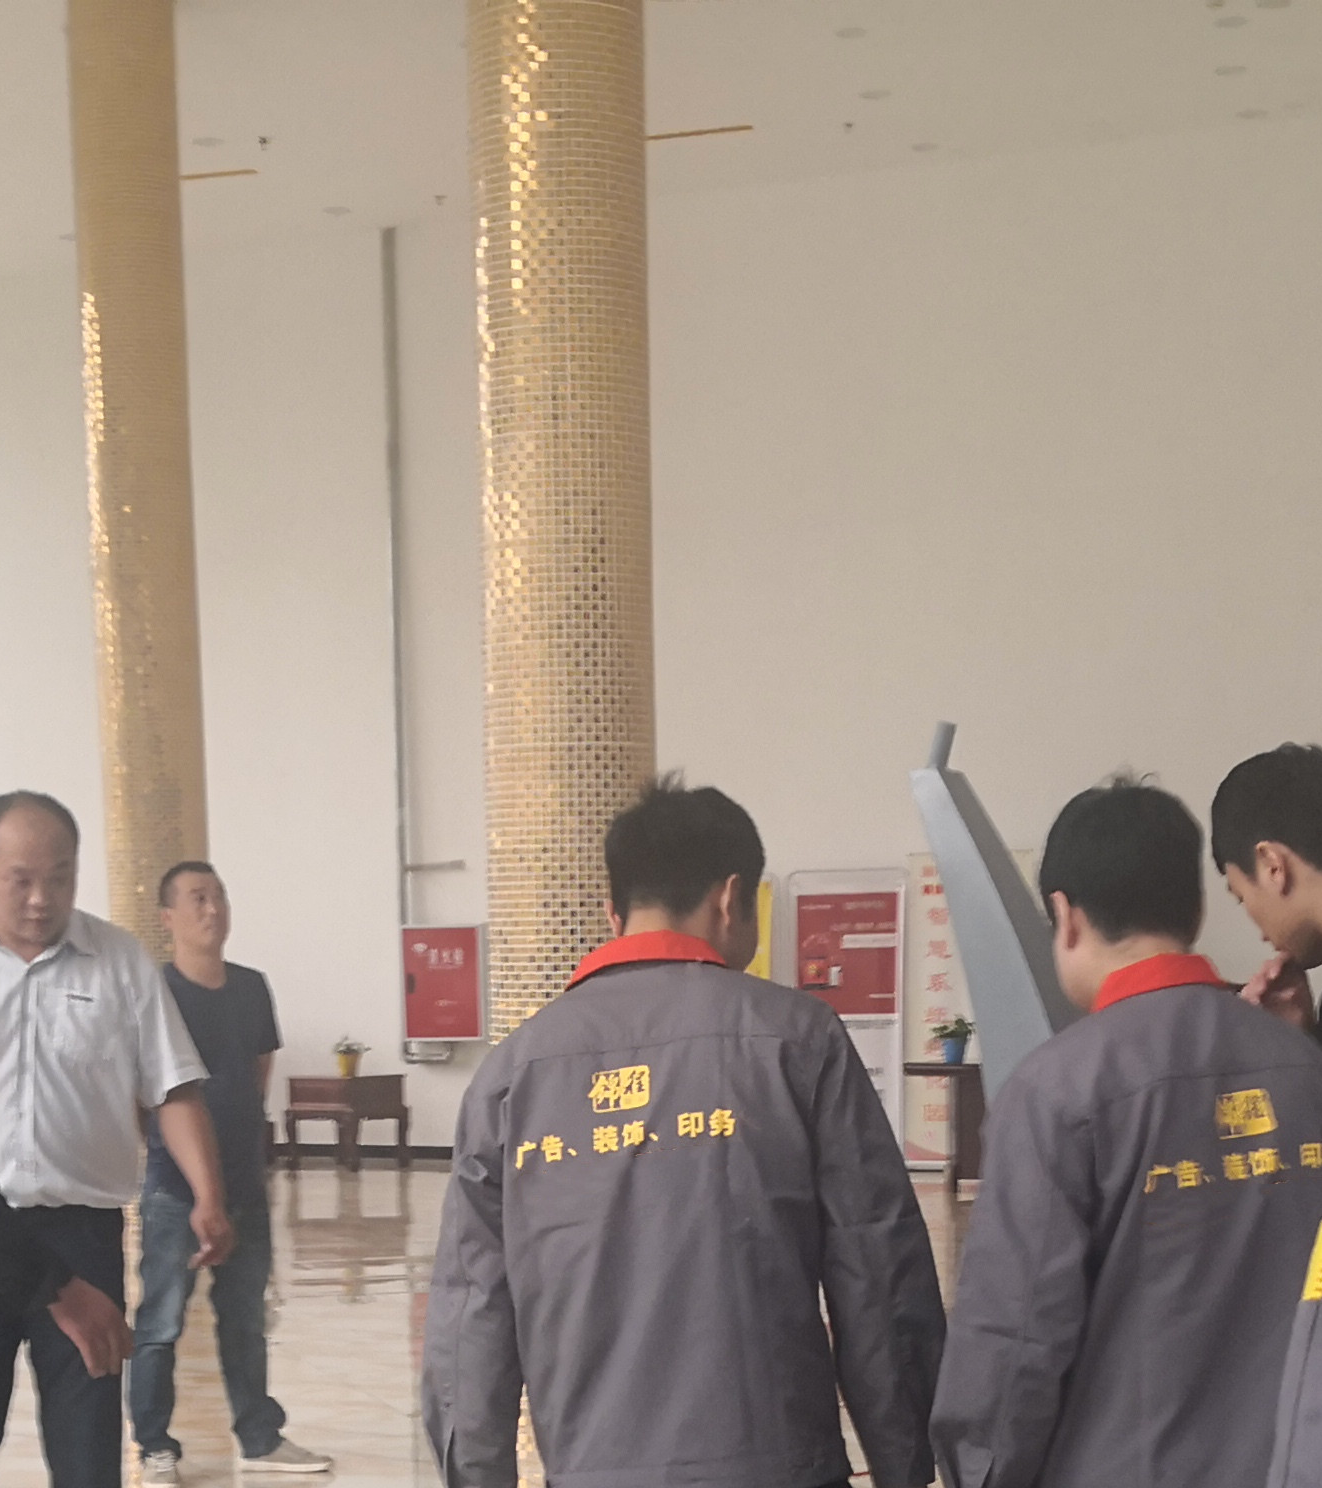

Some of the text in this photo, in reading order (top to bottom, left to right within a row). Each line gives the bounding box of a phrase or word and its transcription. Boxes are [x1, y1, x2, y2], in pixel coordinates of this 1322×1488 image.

[515, 1107, 737, 1170] 广告、装饰、印务
